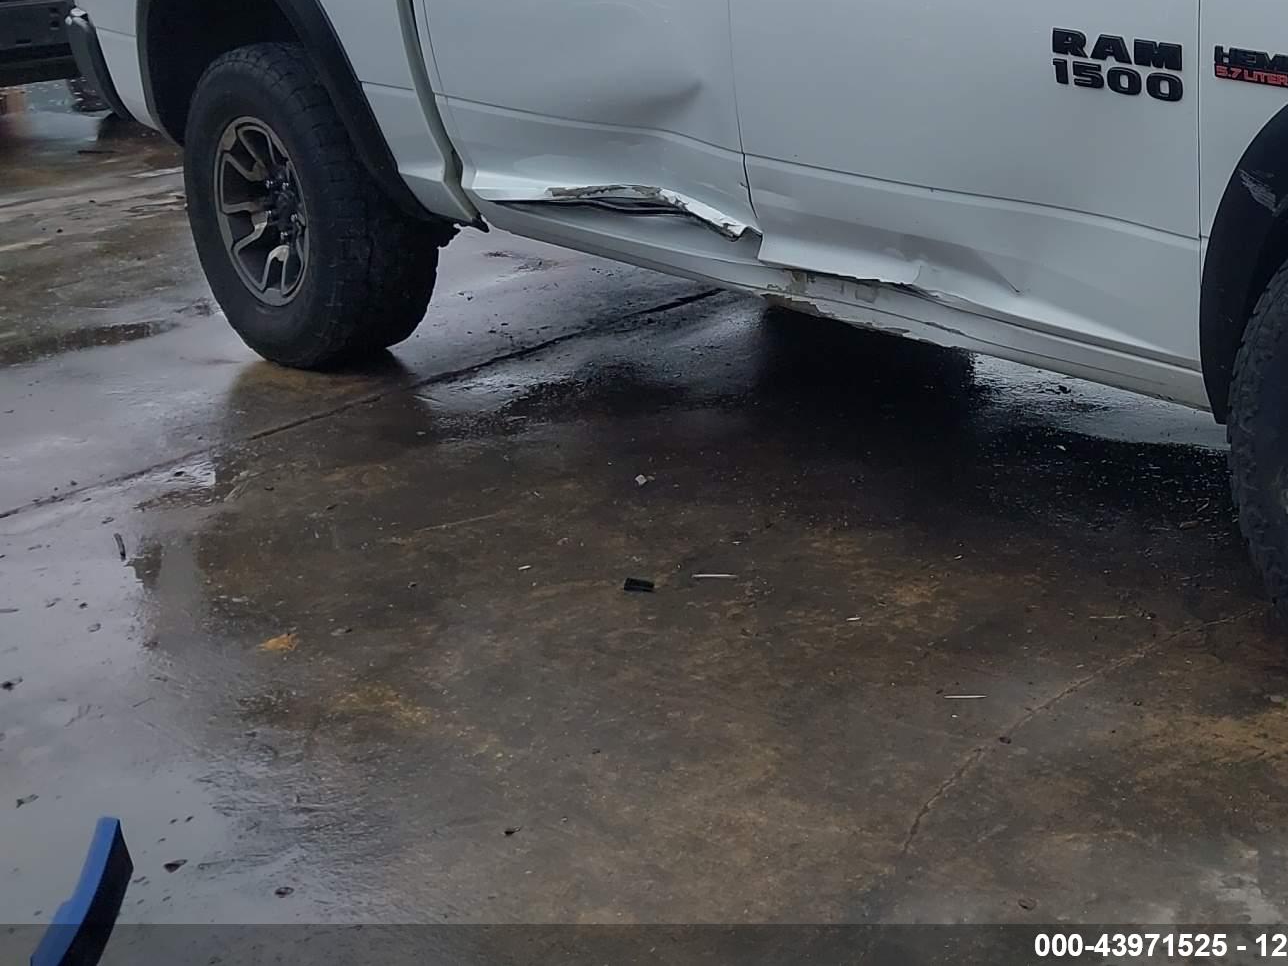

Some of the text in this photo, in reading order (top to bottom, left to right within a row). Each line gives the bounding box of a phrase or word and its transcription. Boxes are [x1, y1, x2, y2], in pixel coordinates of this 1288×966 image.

[1052, 28, 1183, 71] RAM
[1052, 58, 1183, 102] 1500
[1215, 65, 1242, 78] 5.7
